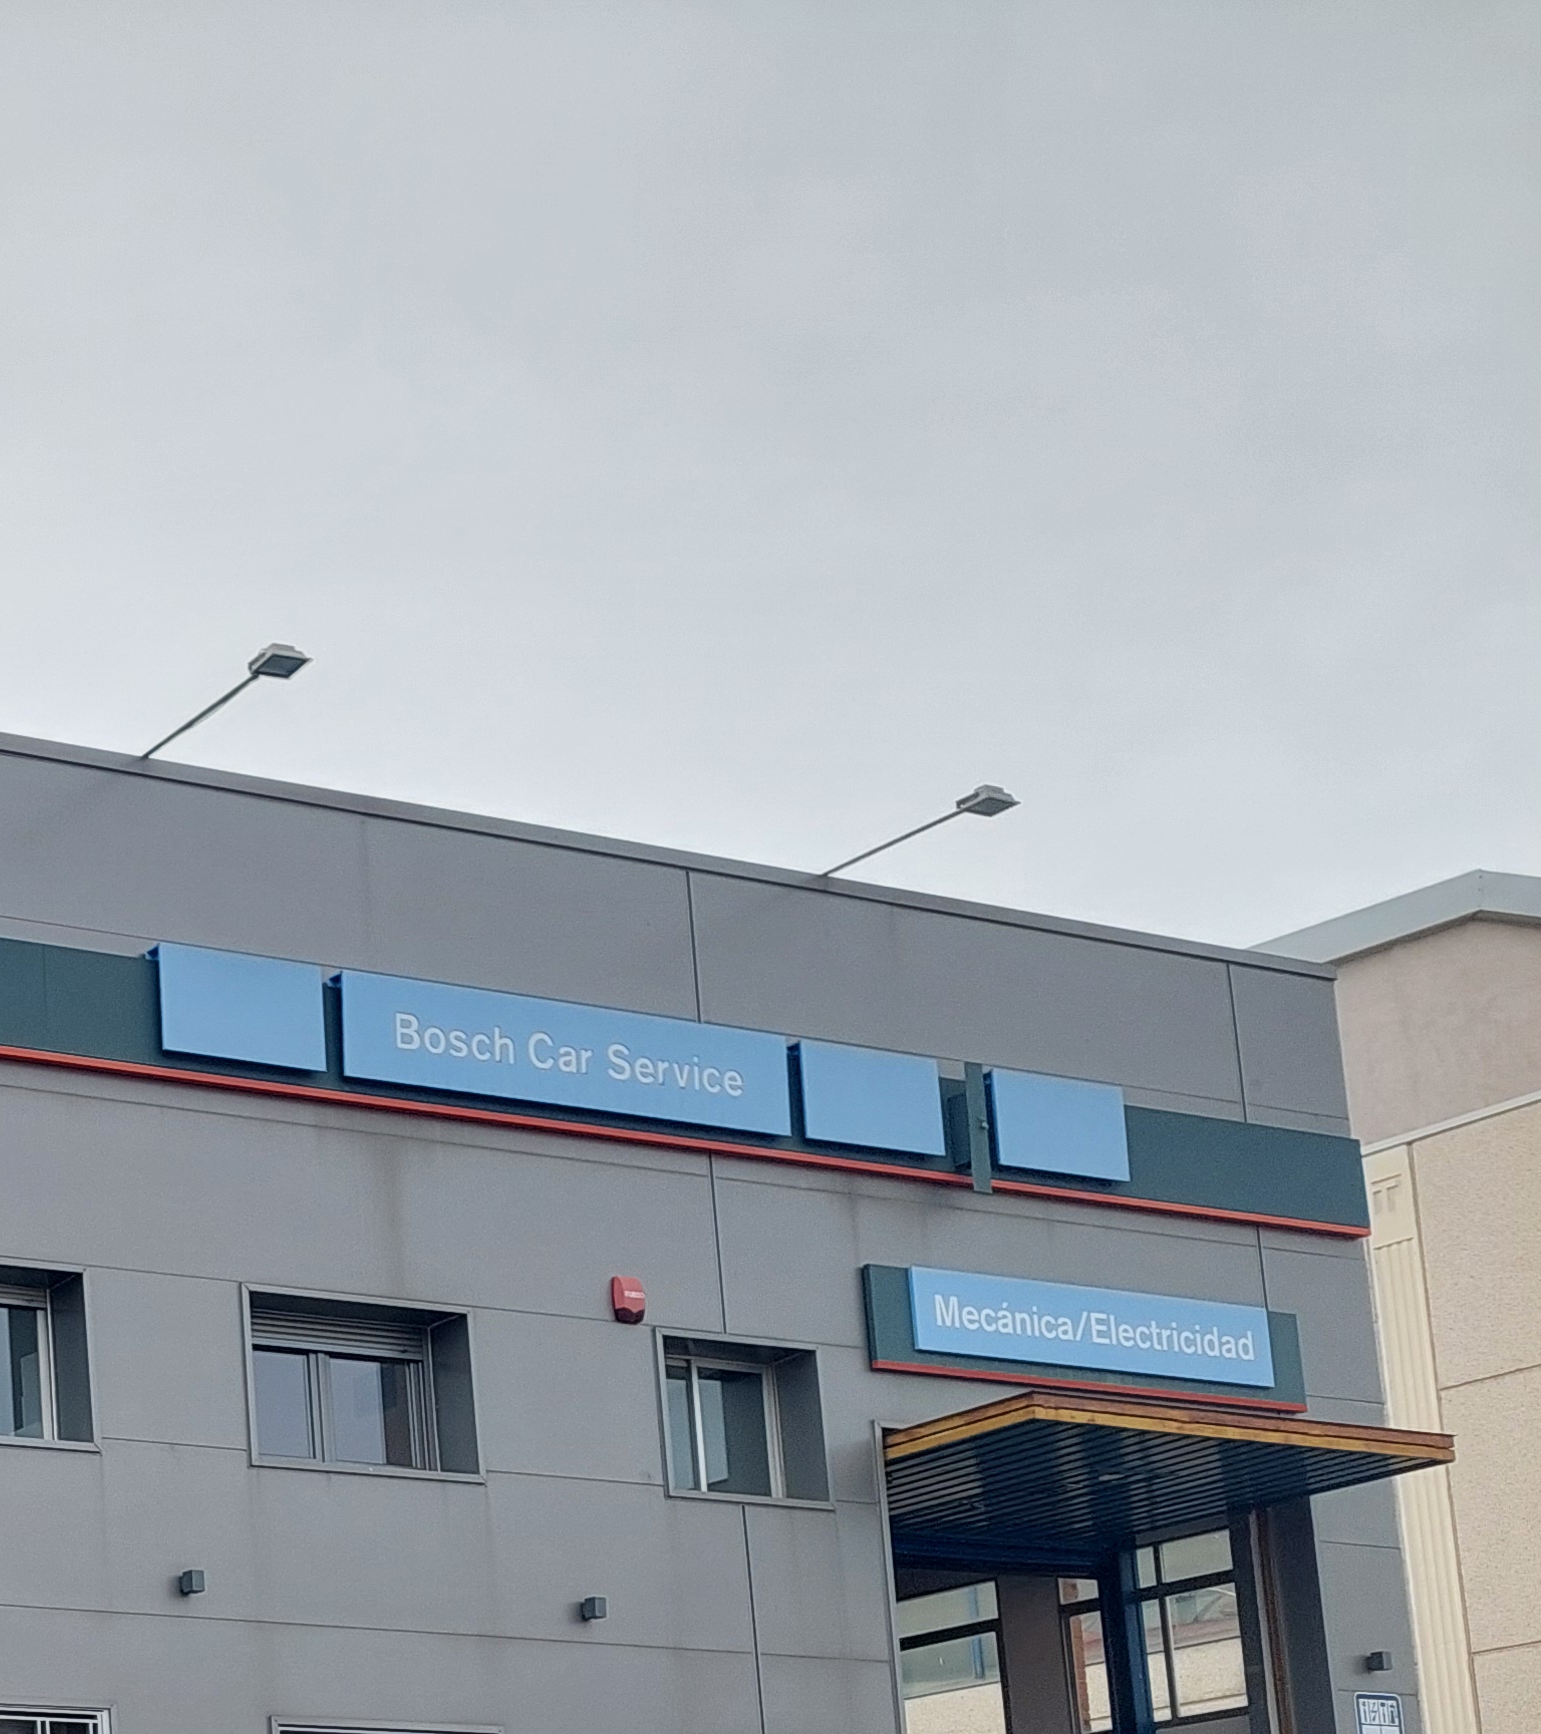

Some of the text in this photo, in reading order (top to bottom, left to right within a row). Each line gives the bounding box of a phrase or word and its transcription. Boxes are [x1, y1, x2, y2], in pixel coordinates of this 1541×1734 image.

[394, 1012, 744, 1097] Bosch Car Service
[933, 1293, 1256, 1362] Mecánica/Electricidad
